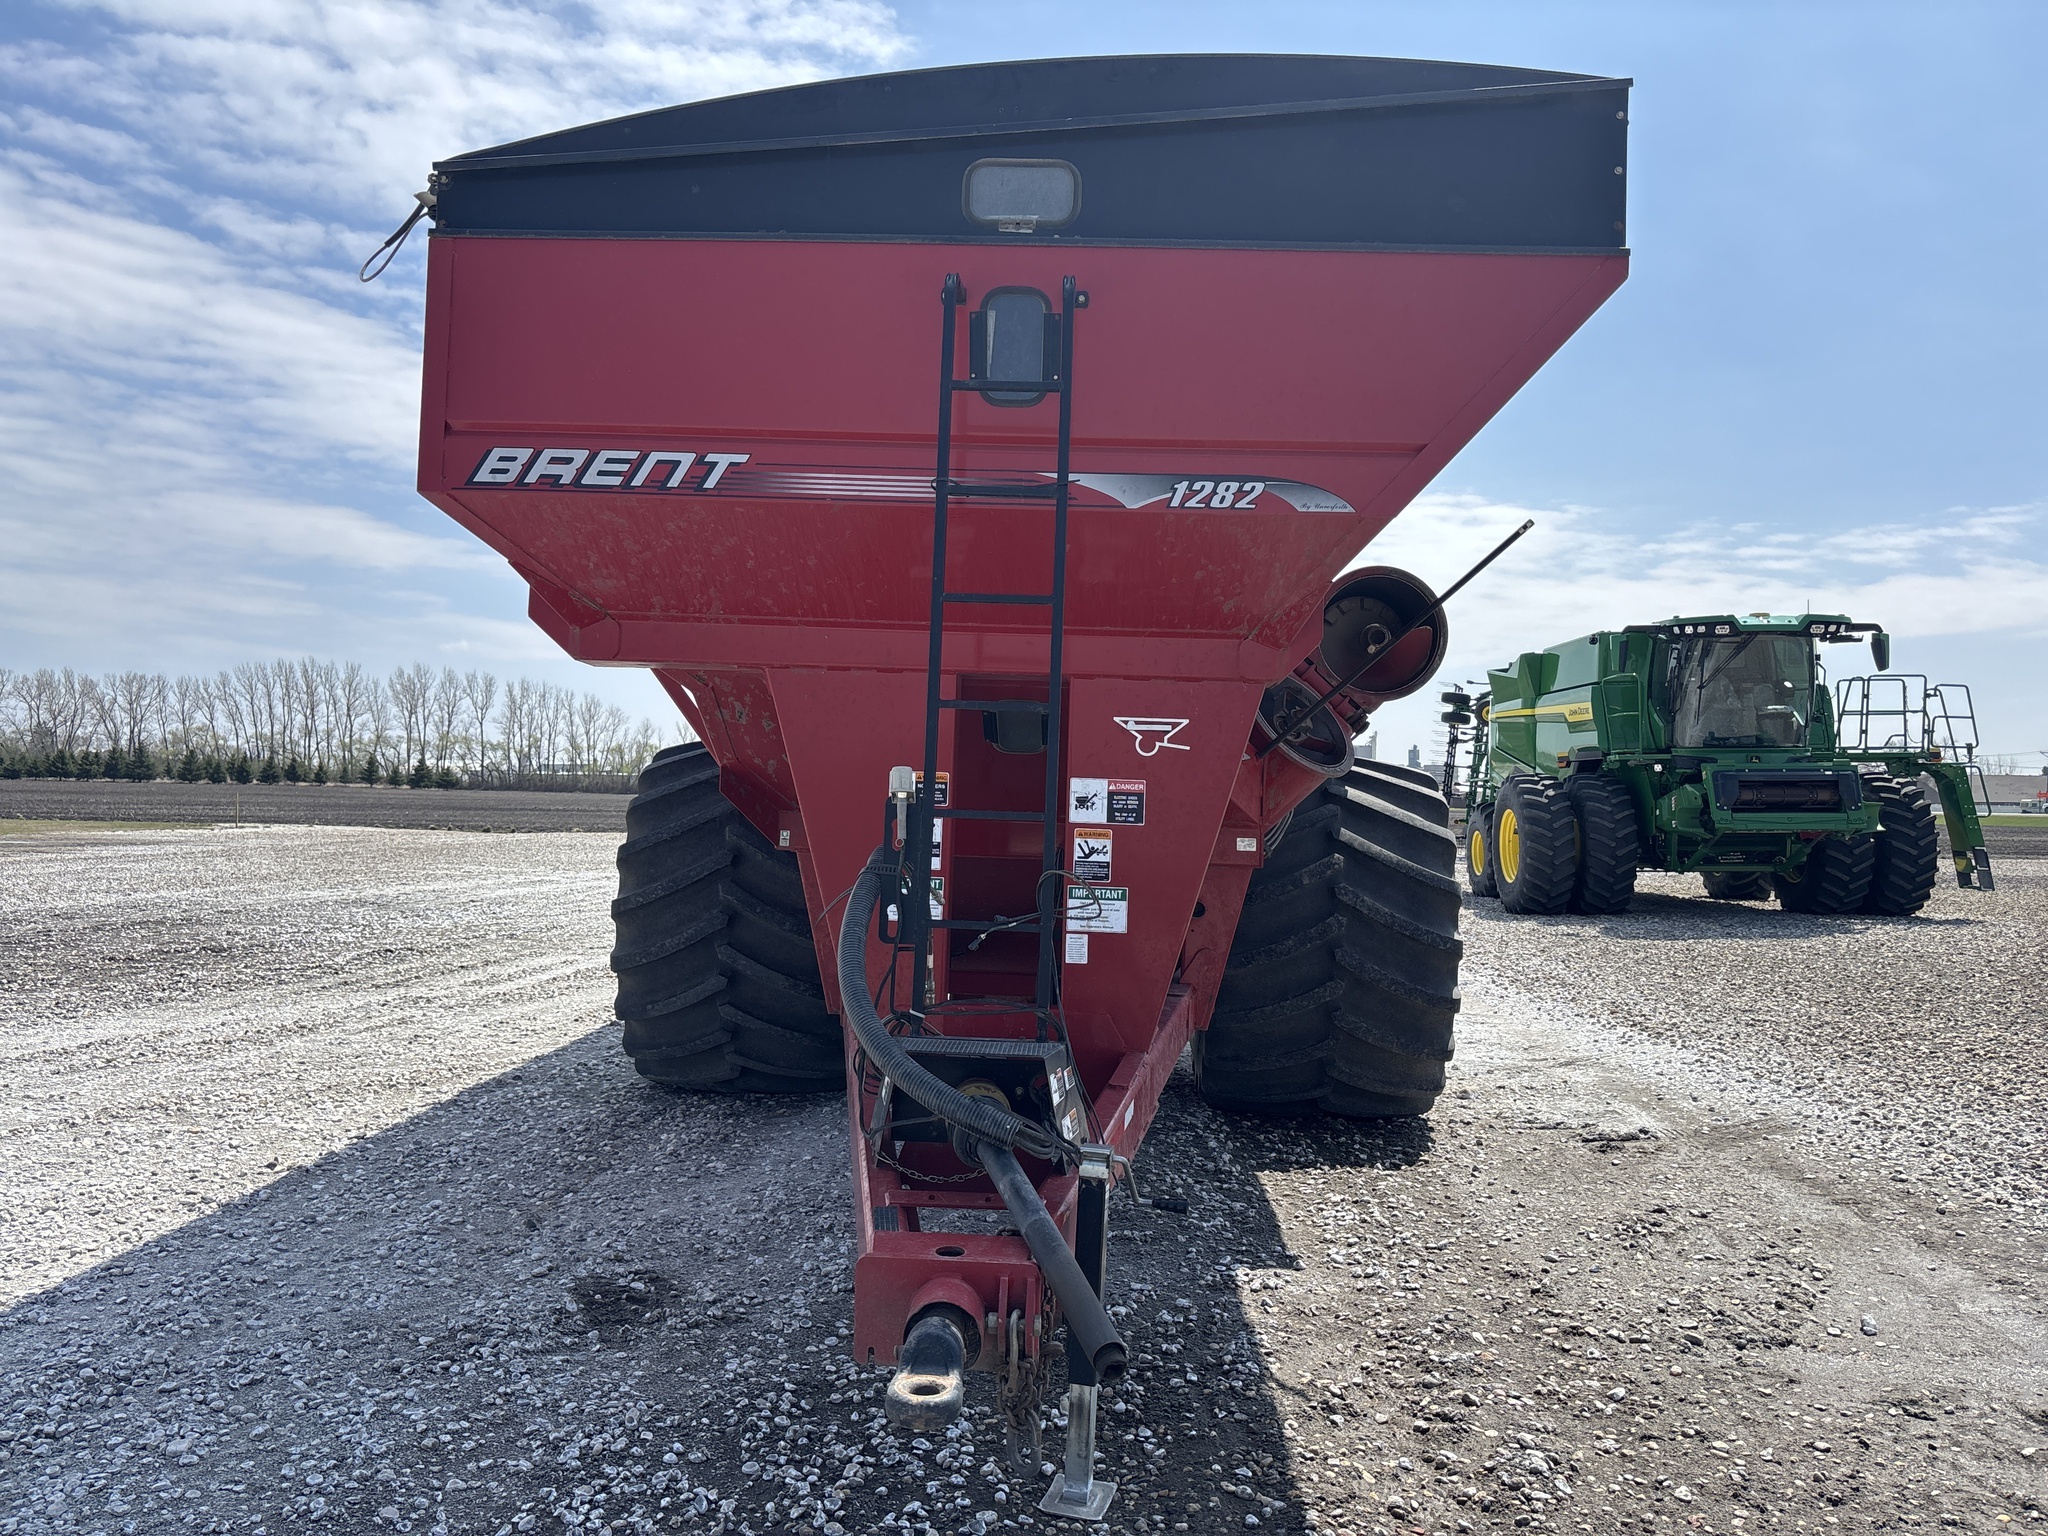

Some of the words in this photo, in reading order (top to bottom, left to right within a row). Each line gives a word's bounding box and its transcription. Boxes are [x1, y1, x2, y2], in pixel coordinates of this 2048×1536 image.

[466, 446, 751, 491] BRENT
[1168, 480, 1266, 510] 1282
[1116, 783, 1144, 791] DANGER
